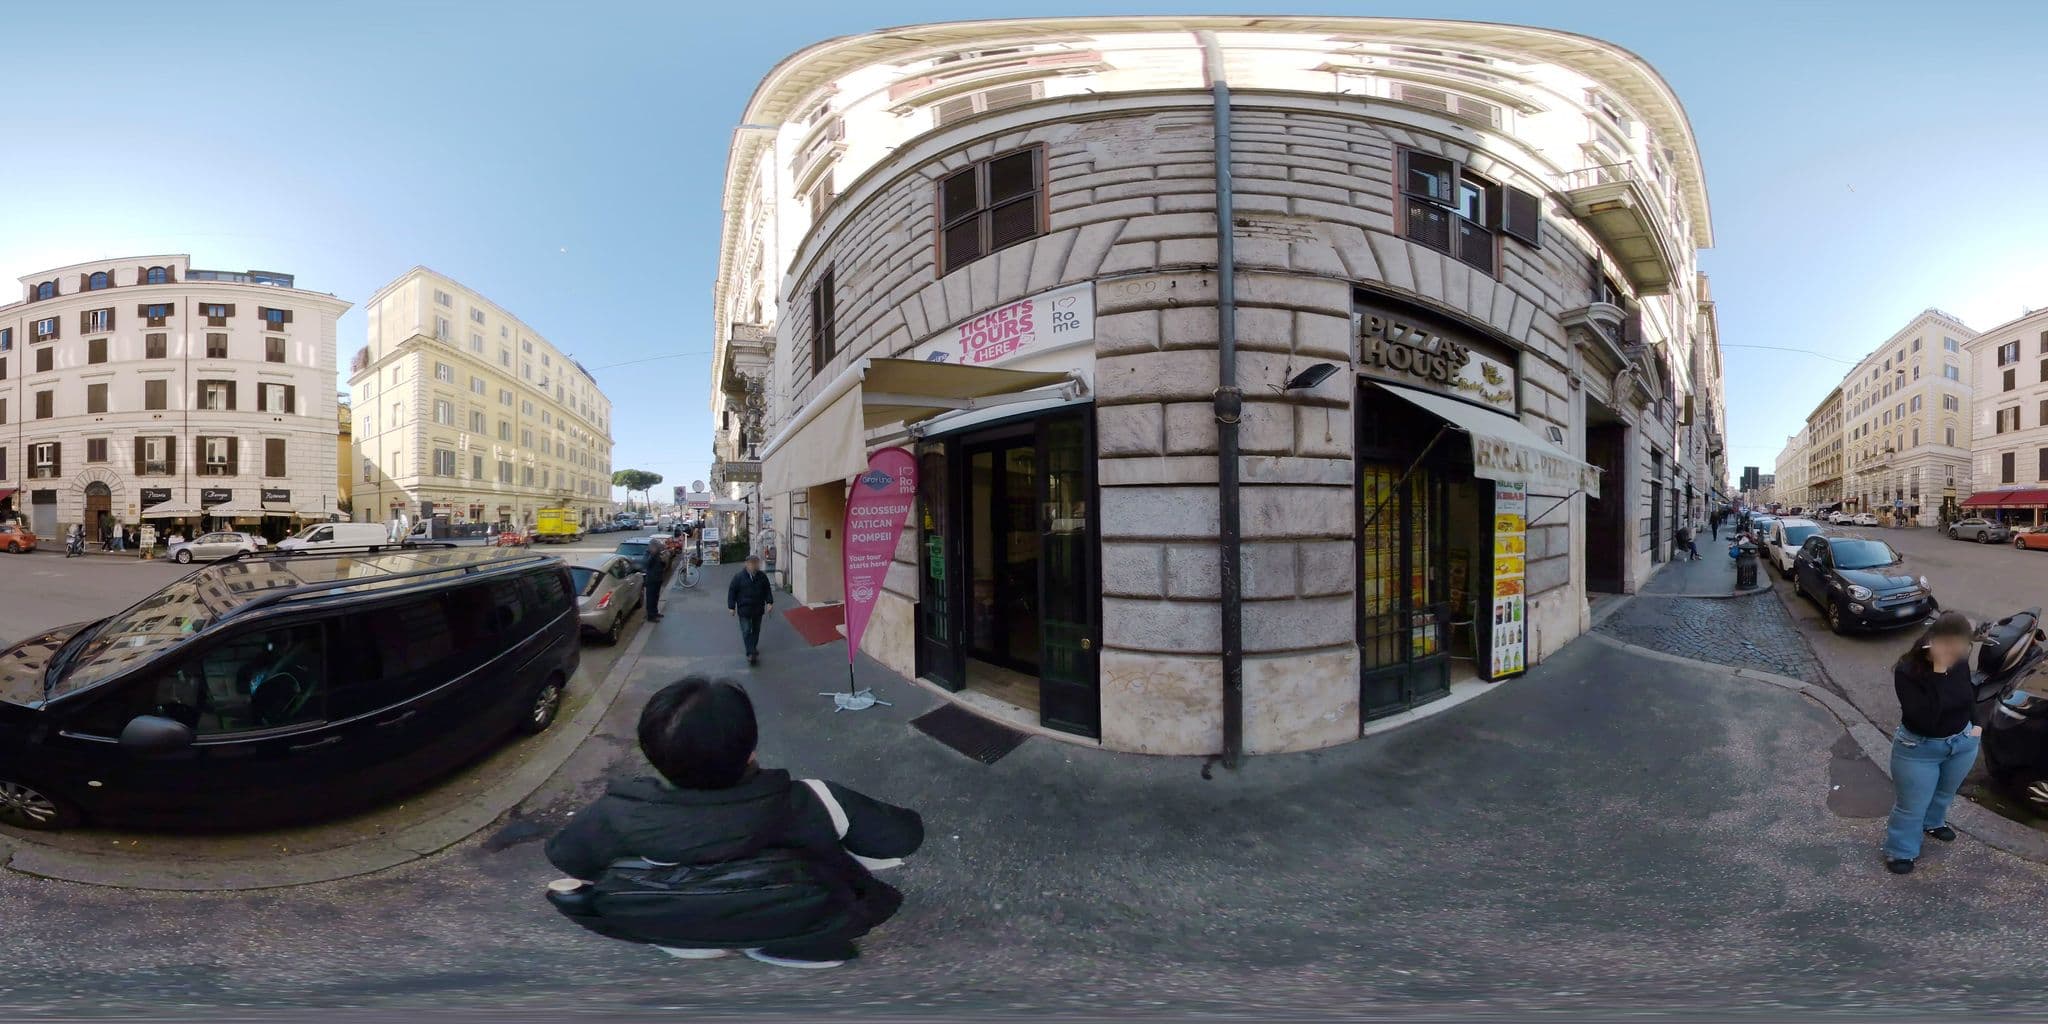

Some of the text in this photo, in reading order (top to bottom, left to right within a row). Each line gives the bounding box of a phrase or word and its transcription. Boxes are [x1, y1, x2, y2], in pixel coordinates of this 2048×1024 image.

[959, 300, 1034, 338] TICKETS
[1053, 311, 1075, 324] Ro
[1053, 319, 1081, 333] me
[959, 314, 1034, 354] TOURS
[1360, 313, 1471, 366] PIZZA'S
[979, 341, 1011, 361] HERE
[1360, 336, 1460, 386] HOUSE
[851, 505, 908, 515] COLOSSEUM
[851, 520, 892, 529] VATICAN
[852, 532, 891, 542] POMPEII
[849, 553, 865, 562] Your
[849, 561, 869, 569] starts
